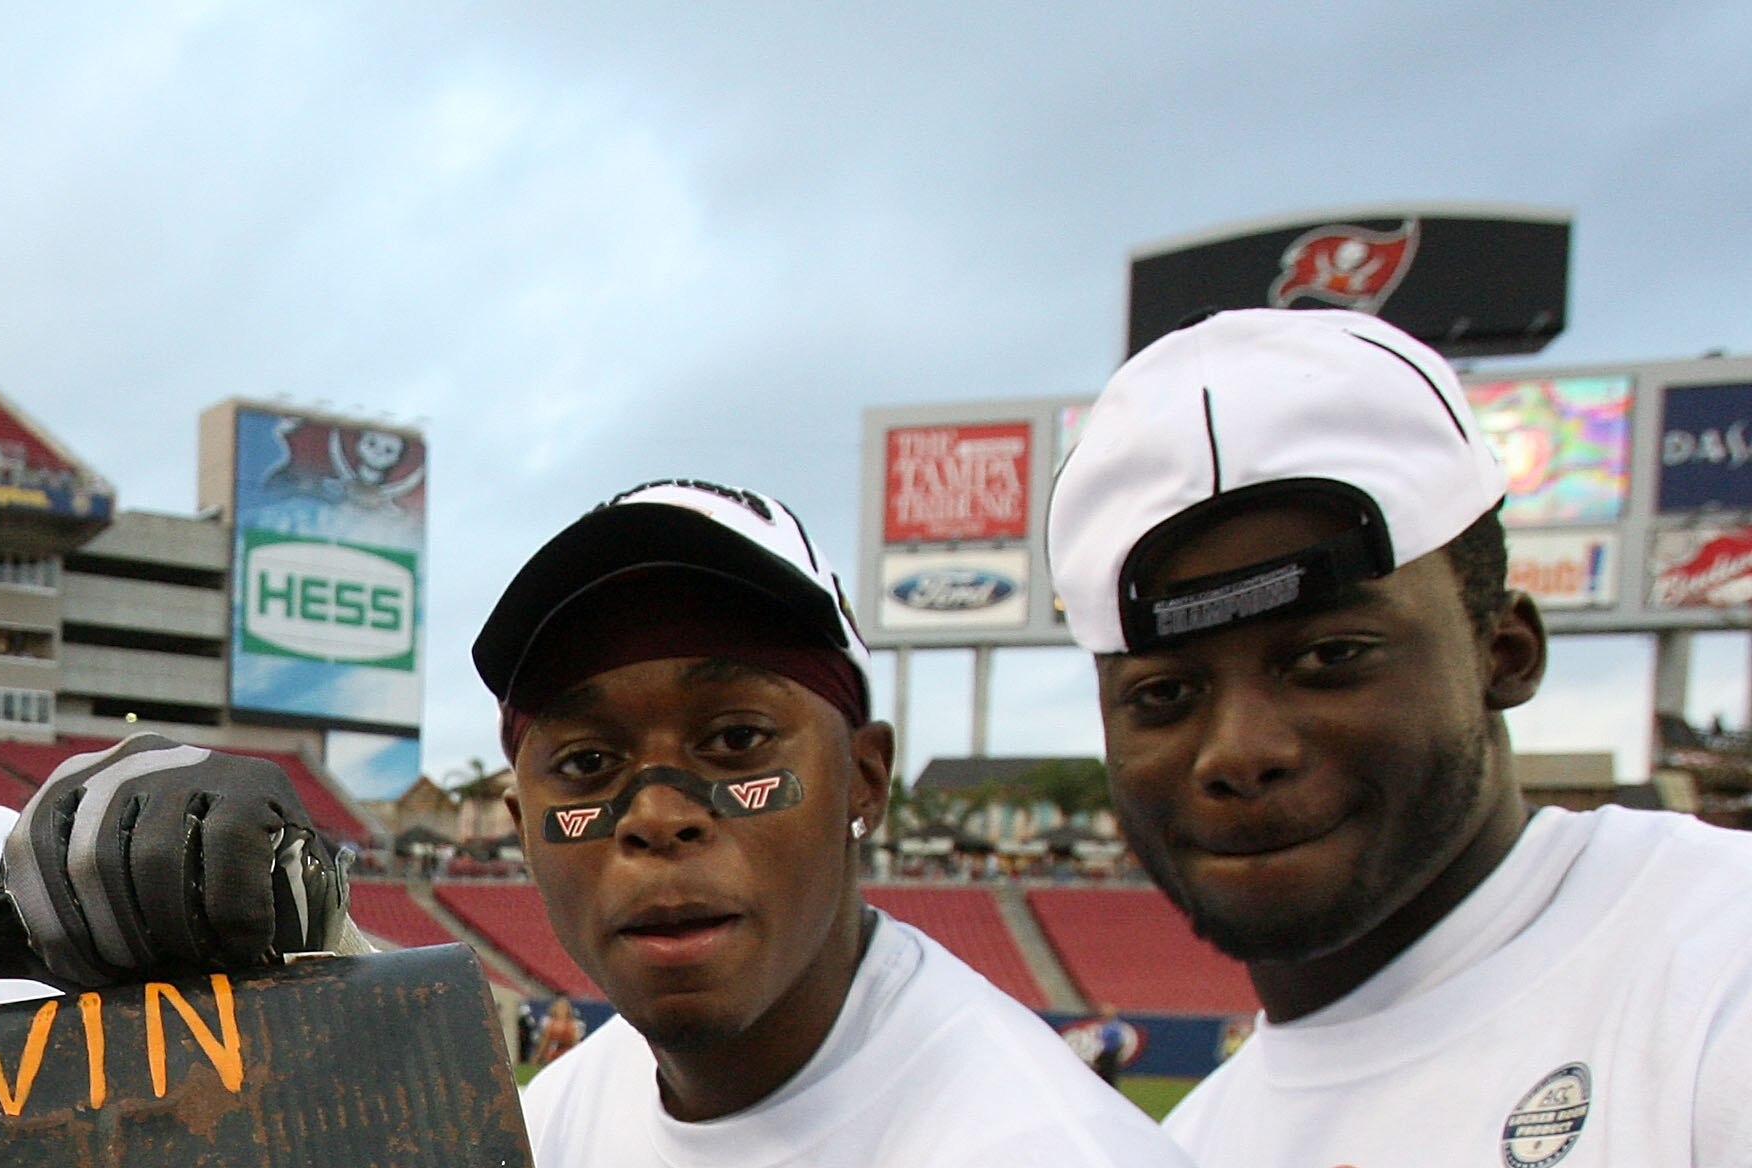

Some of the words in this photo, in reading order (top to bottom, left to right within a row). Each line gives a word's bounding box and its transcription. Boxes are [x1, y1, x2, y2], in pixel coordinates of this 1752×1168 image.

[1662, 422, 1752, 470] DAS
[258, 570, 402, 632] HESS
[908, 572, 1000, 609] Ford
[727, 776, 781, 810] VT
[556, 806, 602, 838] VT
